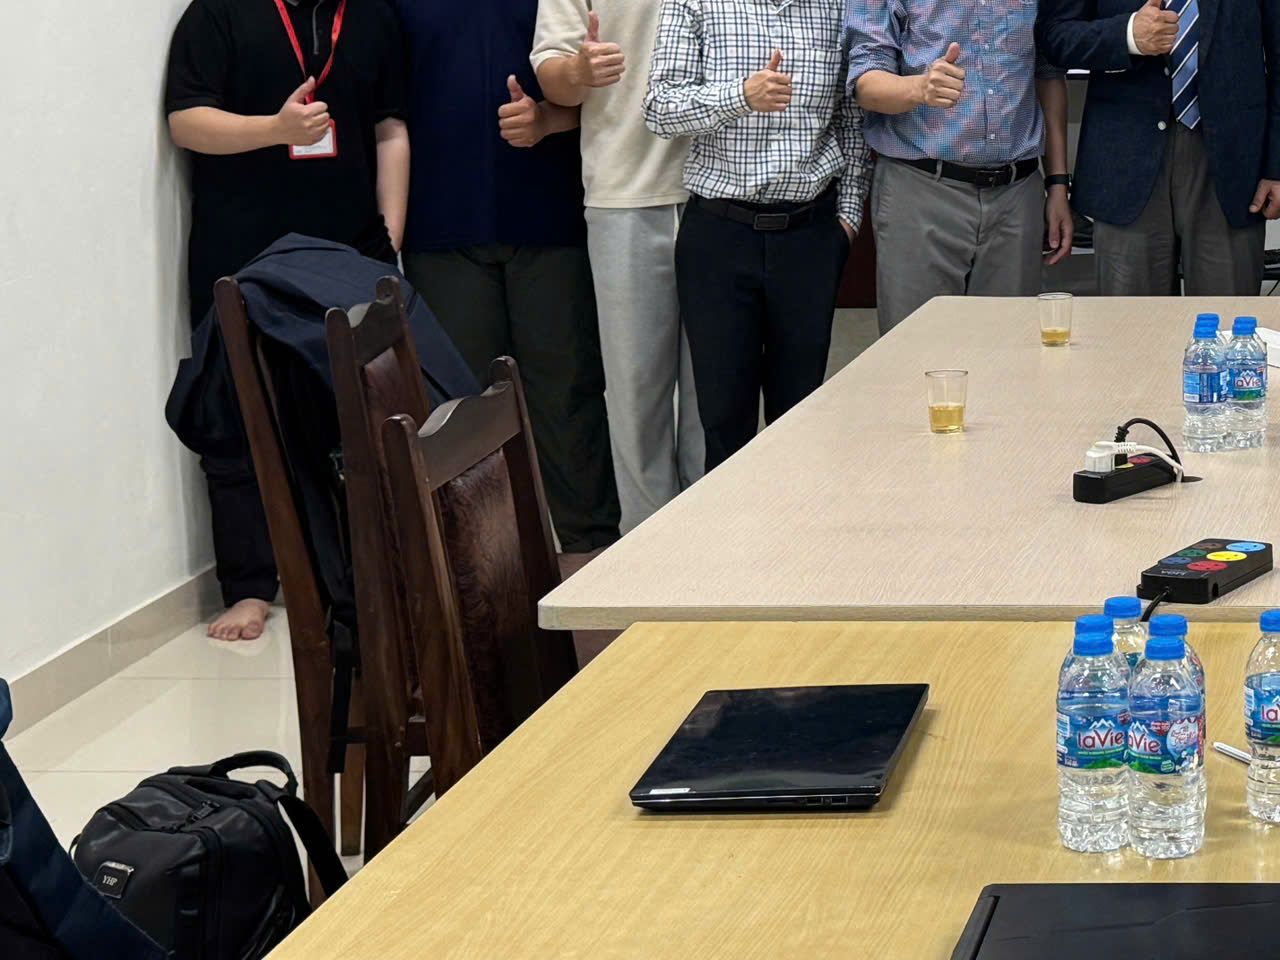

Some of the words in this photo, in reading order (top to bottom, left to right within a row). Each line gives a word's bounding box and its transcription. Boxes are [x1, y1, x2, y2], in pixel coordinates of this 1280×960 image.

[1236, 375, 1261, 388] aVie
[1077, 727, 1125, 749] laVie
[1128, 728, 1161, 754] Vie
[102, 874, 118, 887] YHP
